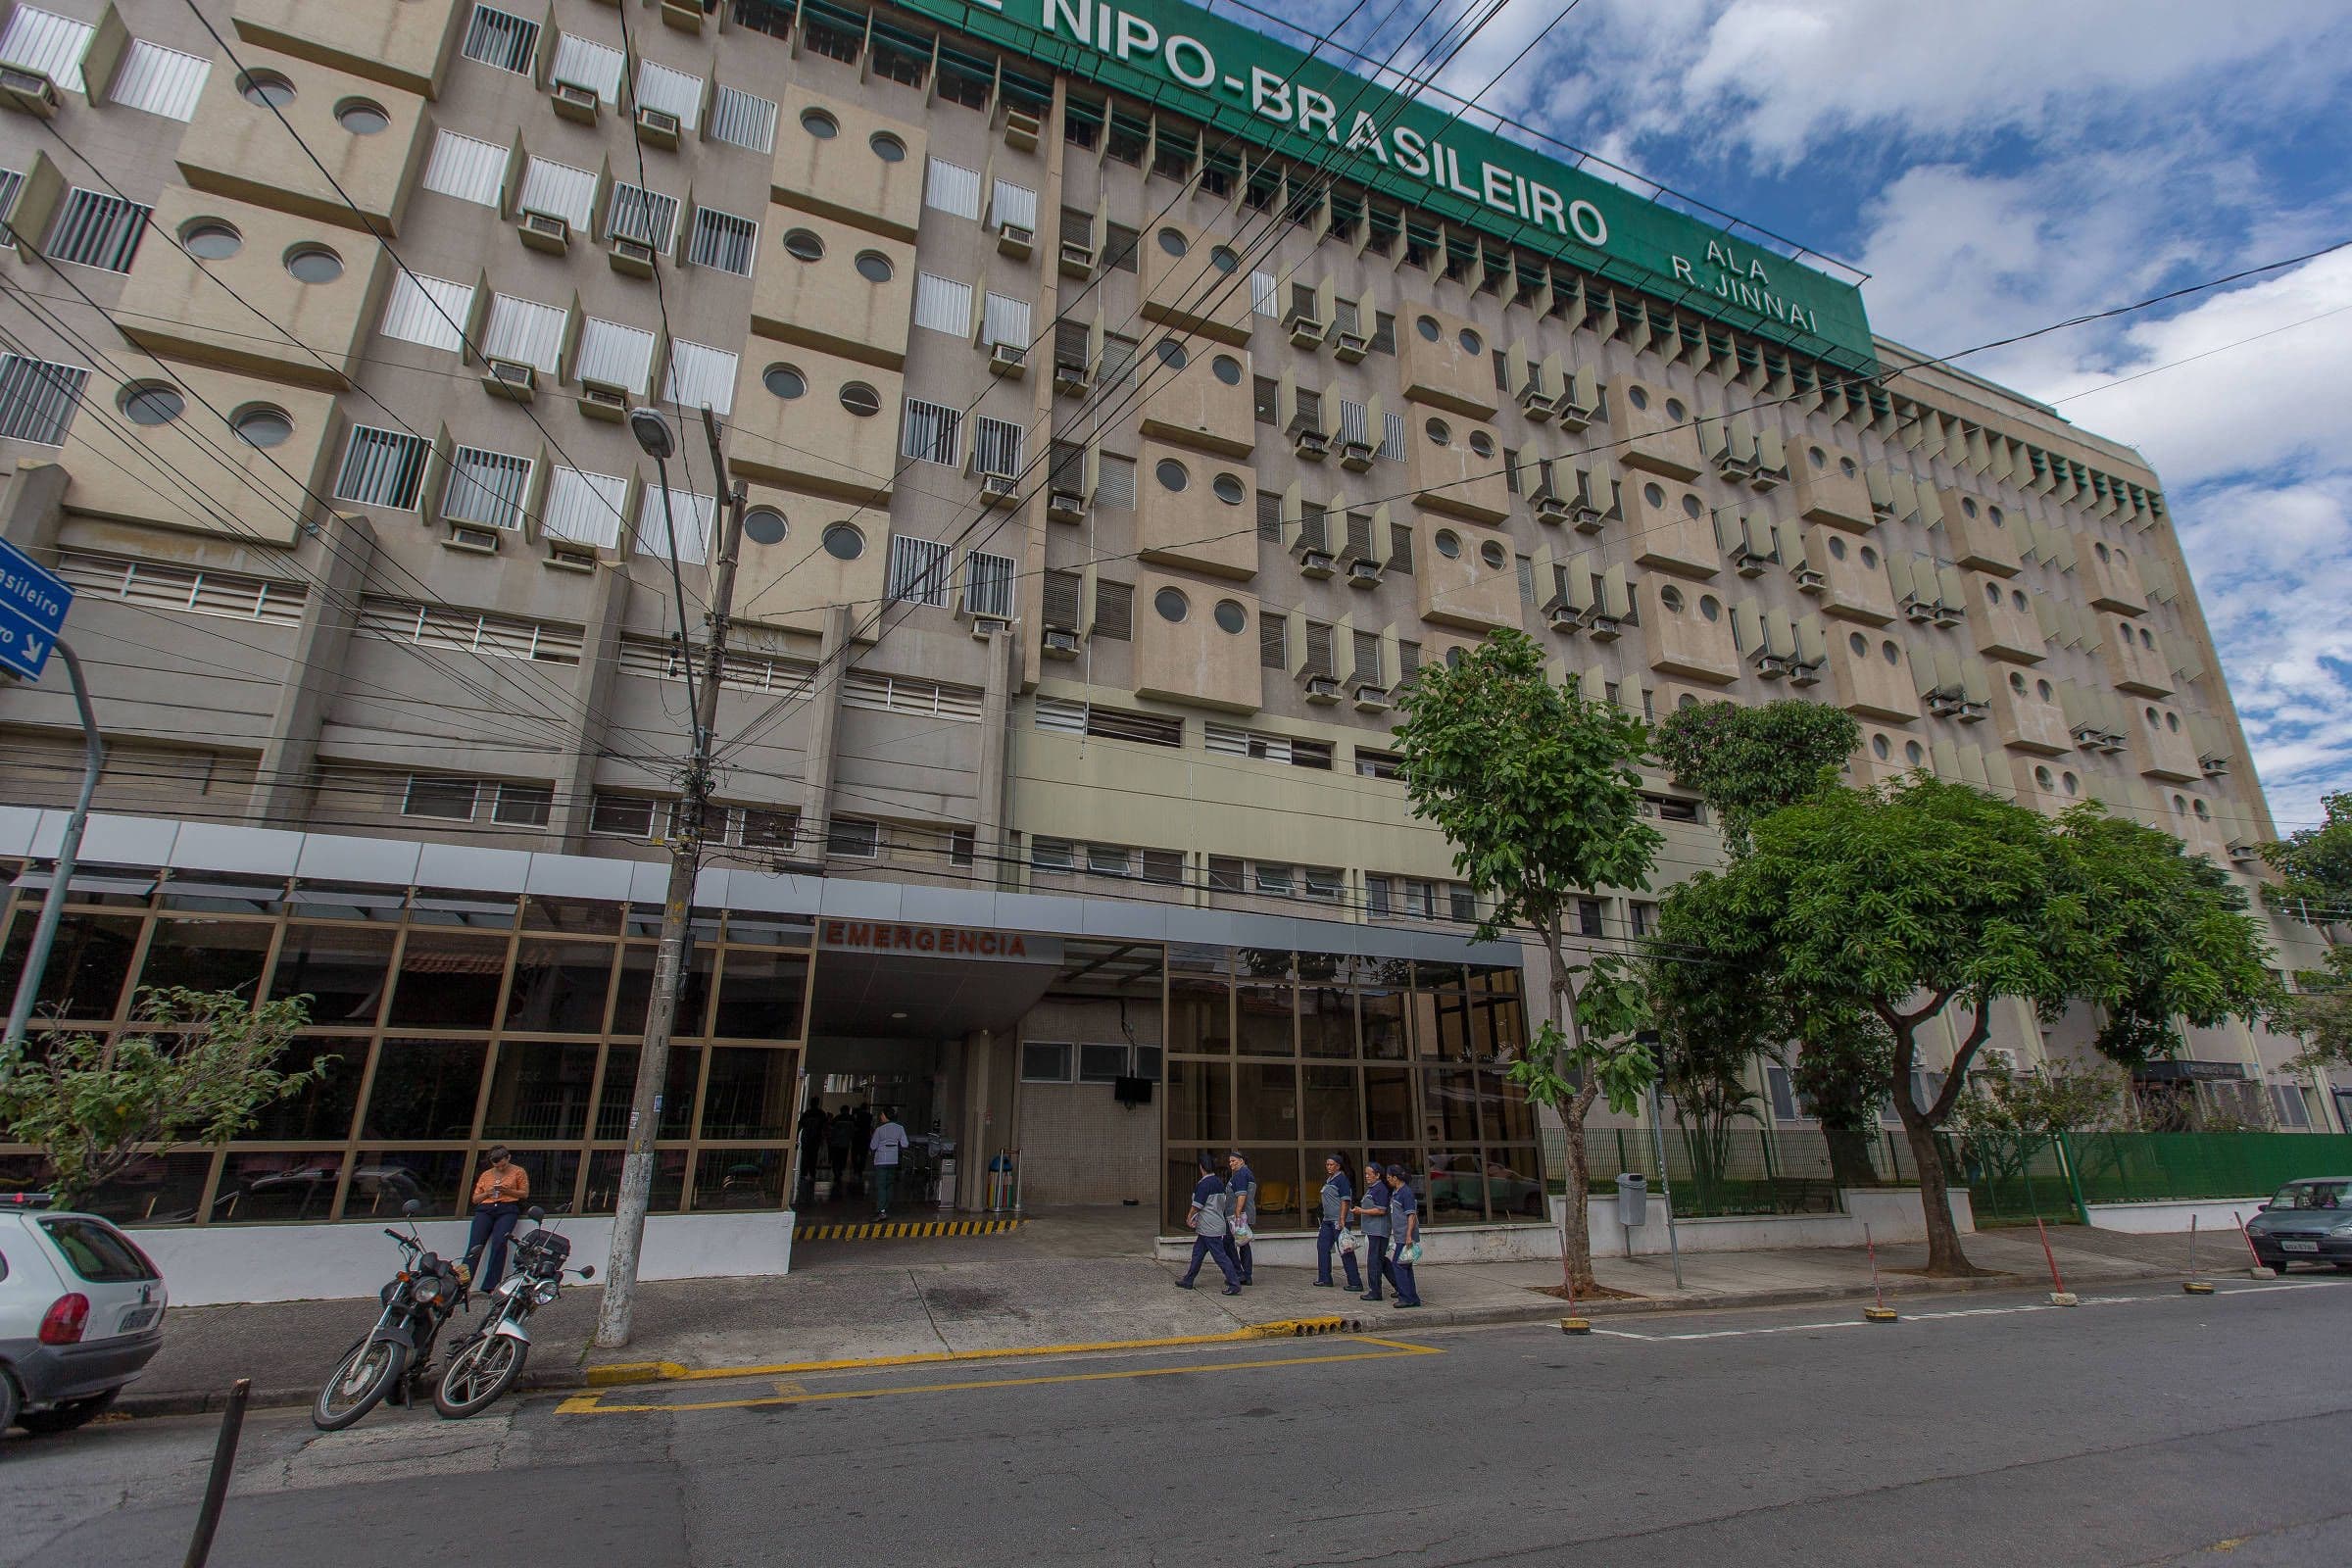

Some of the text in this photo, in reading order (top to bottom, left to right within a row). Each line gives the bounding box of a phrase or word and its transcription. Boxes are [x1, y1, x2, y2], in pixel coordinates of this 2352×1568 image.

[1043, 0, 1607, 247] NIPO-BRASILEIRO
[1707, 240, 1769, 285] ALA
[1715, 273, 1817, 333] JINNAI
